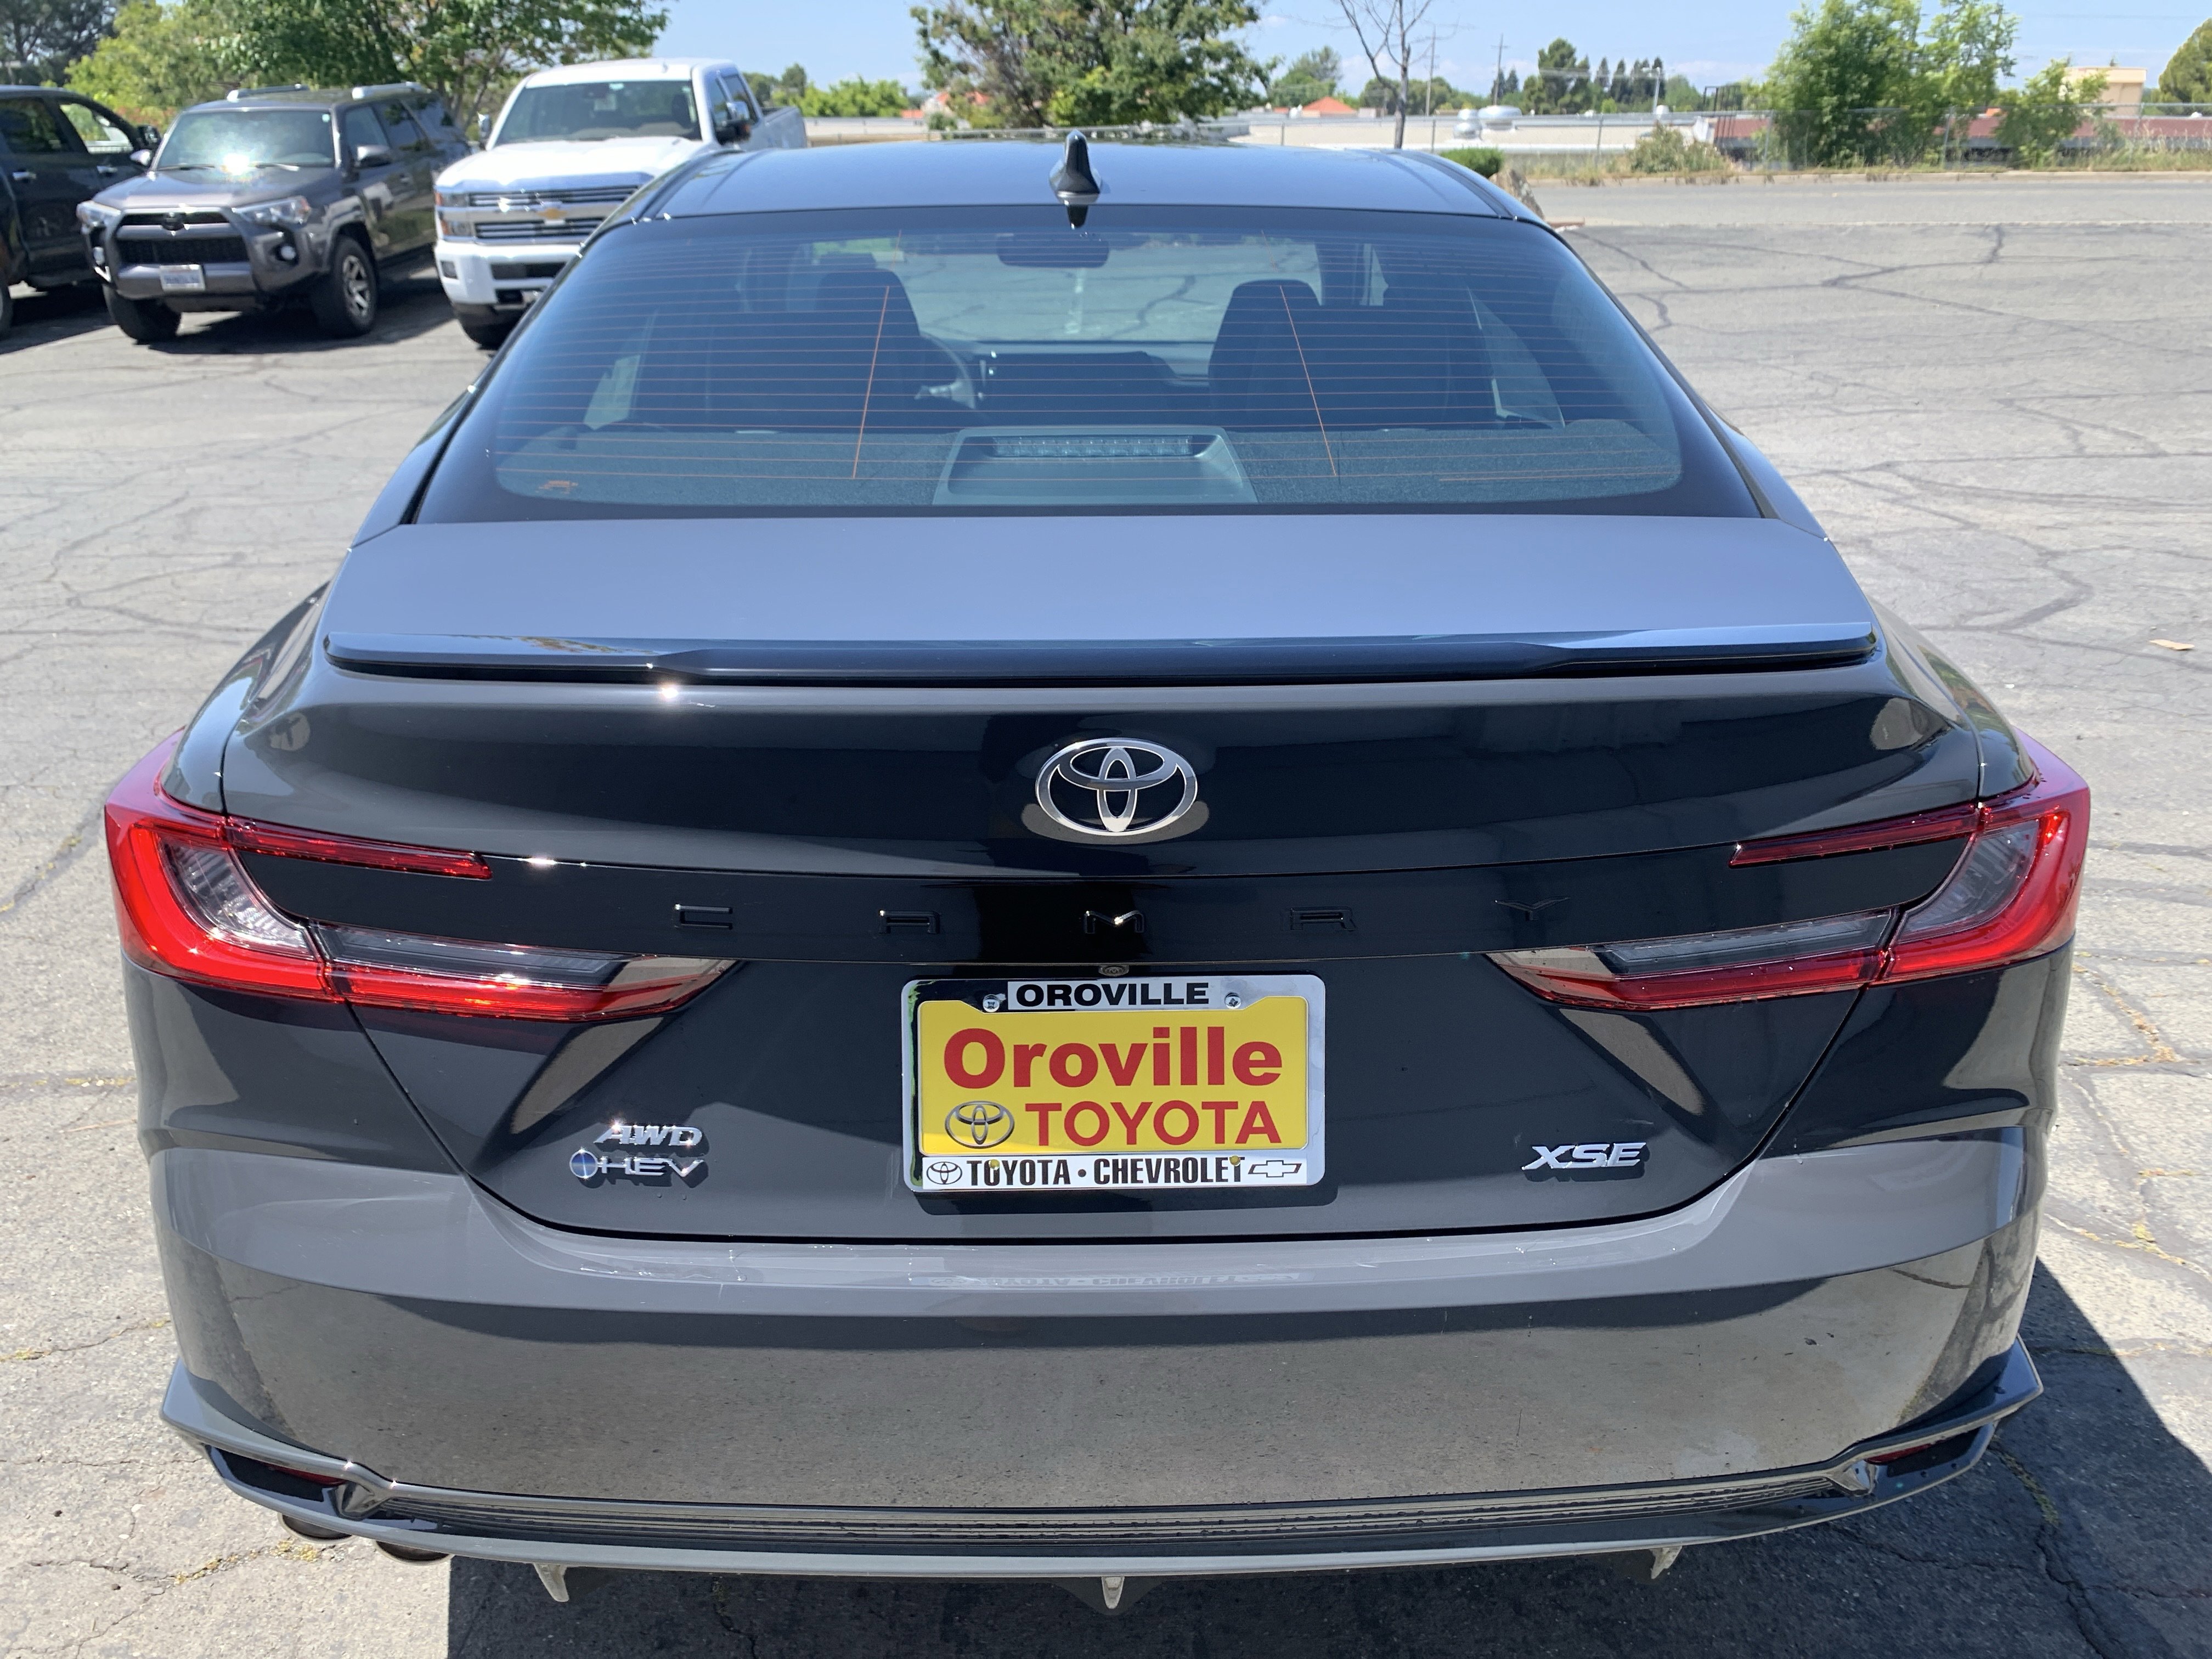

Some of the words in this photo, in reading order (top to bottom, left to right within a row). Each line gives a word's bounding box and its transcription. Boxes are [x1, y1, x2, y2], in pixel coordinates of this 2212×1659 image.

[673, 897, 1570, 934] CAMRY
[1016, 983, 1209, 1007] OROVILLE
[944, 1026, 1283, 1088] Oroville
[594, 1124, 702, 1146] AWD
[1025, 1101, 1282, 1147] TOYOTA
[598, 1156, 704, 1177] HEV
[1521, 1142, 1646, 1170] XSE
[967, 1159, 1070, 1186] TOYOTA
[1093, 1156, 1245, 1186] CHEVROLET
